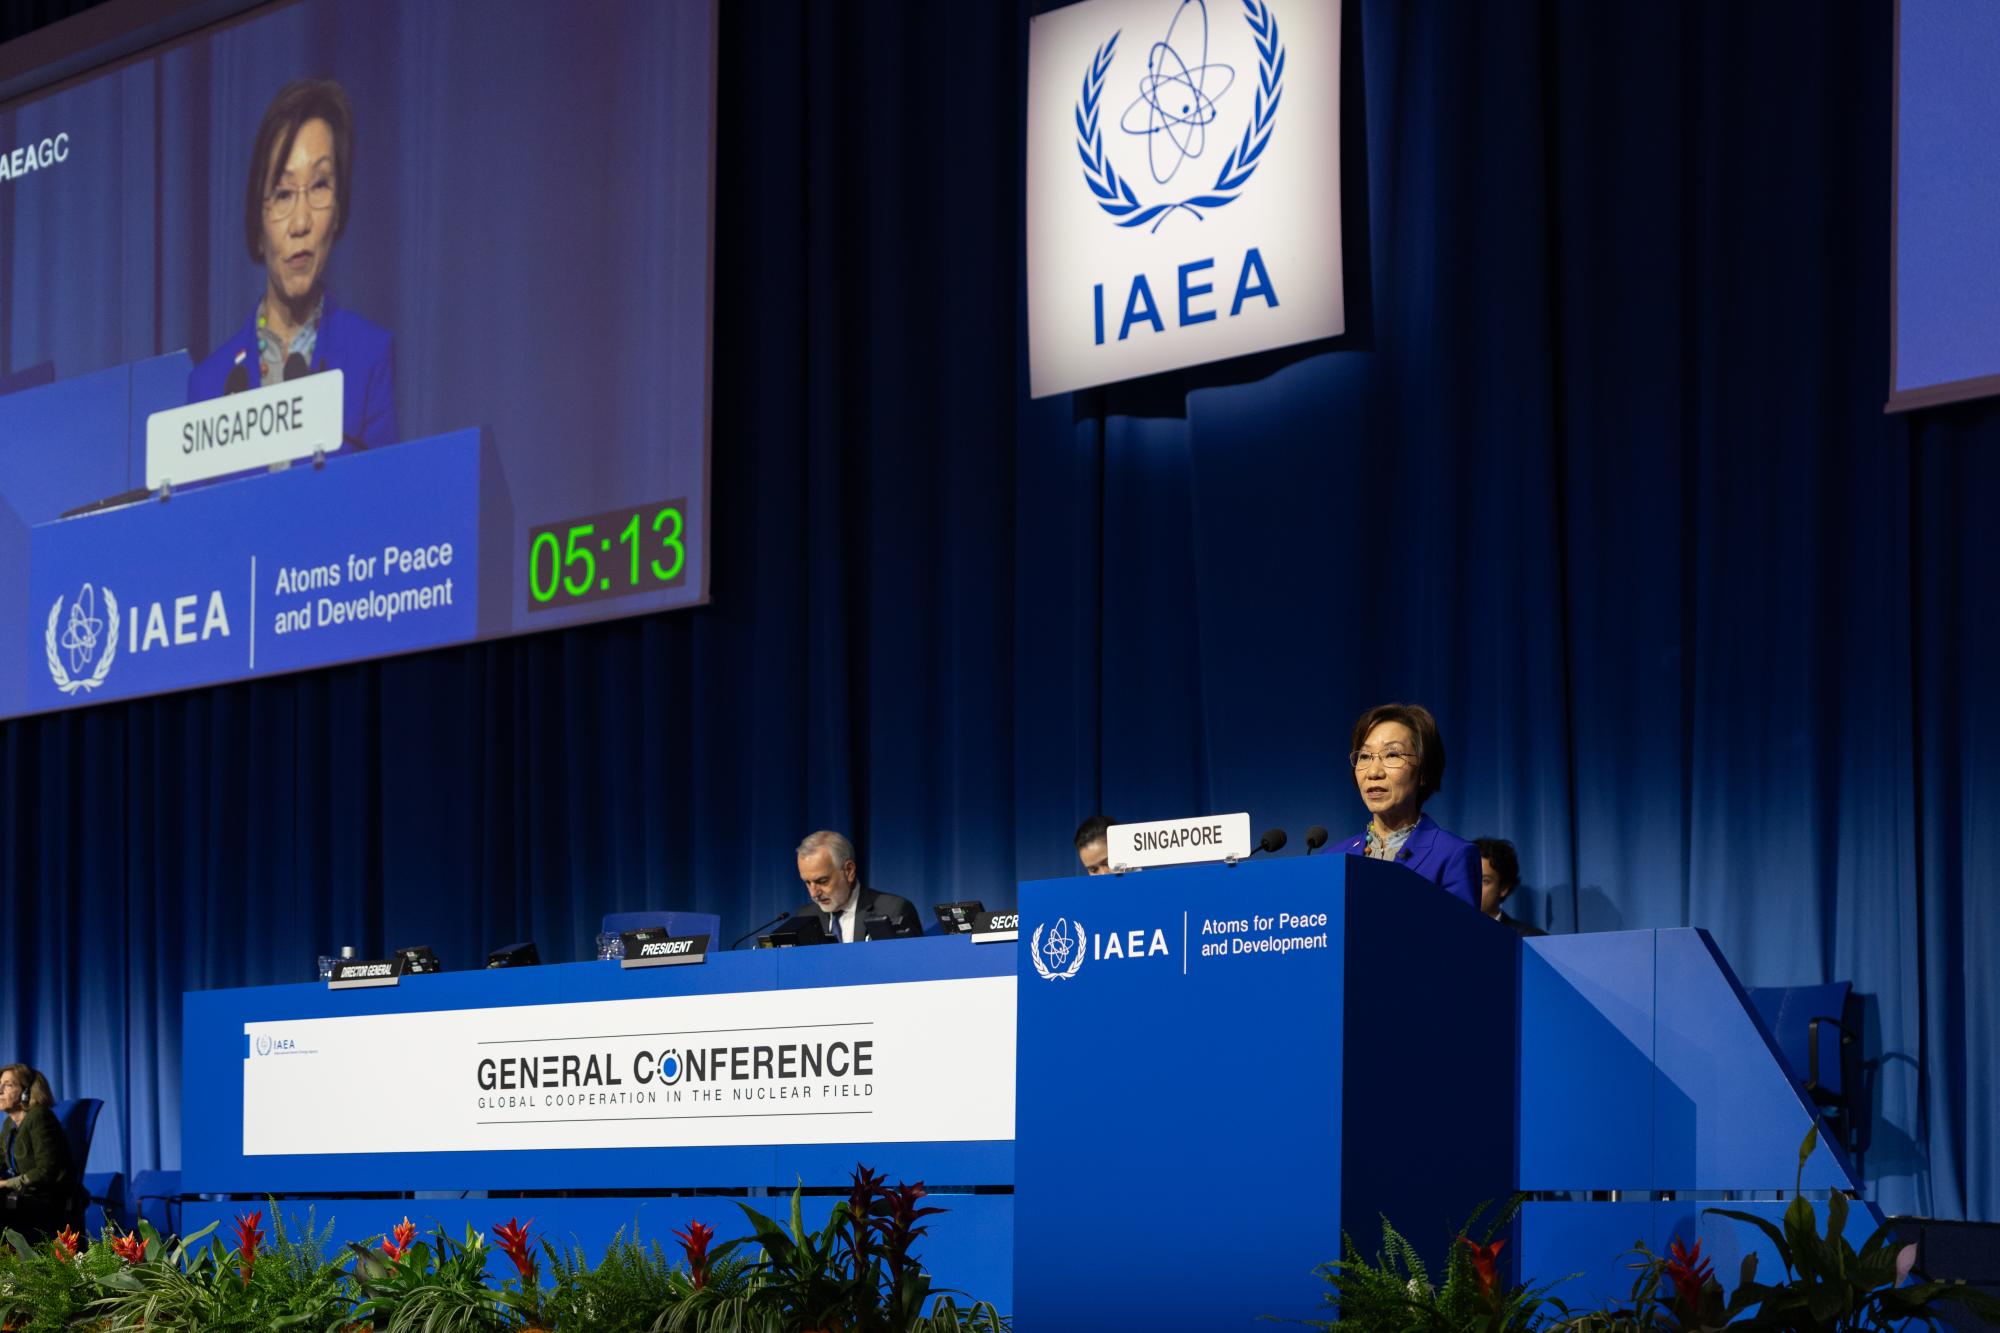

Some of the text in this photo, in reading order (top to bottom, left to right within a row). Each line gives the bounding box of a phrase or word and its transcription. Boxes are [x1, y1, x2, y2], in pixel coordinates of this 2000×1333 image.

[0, 132, 69, 182] AEAGC
[1094, 247, 1279, 345] IAEA
[182, 396, 304, 455] SINGAPORE
[275, 542, 453, 597] Atoms for Peace
[530, 508, 685, 602] 05:13
[129, 590, 230, 653] IAEA
[275, 579, 453, 636] and Development
[1133, 825, 1222, 851] SINGAPORE
[990, 914, 1019, 930] SECR
[1202, 912, 1327, 935] Atoms for Peace
[640, 940, 693, 956] PRESIDENT
[1094, 929, 1169, 960] IAEA
[1201, 934, 1328, 957] and Development
[340, 964, 392, 978] DIRECTOR GENERAL
[273, 1039, 295, 1050] IAEA
[477, 1040, 873, 1090] GENERAL CONFERENCE
[478, 1083, 873, 1109] GLOBAL COOPERATION IN THE NUCLEAR FIELD
